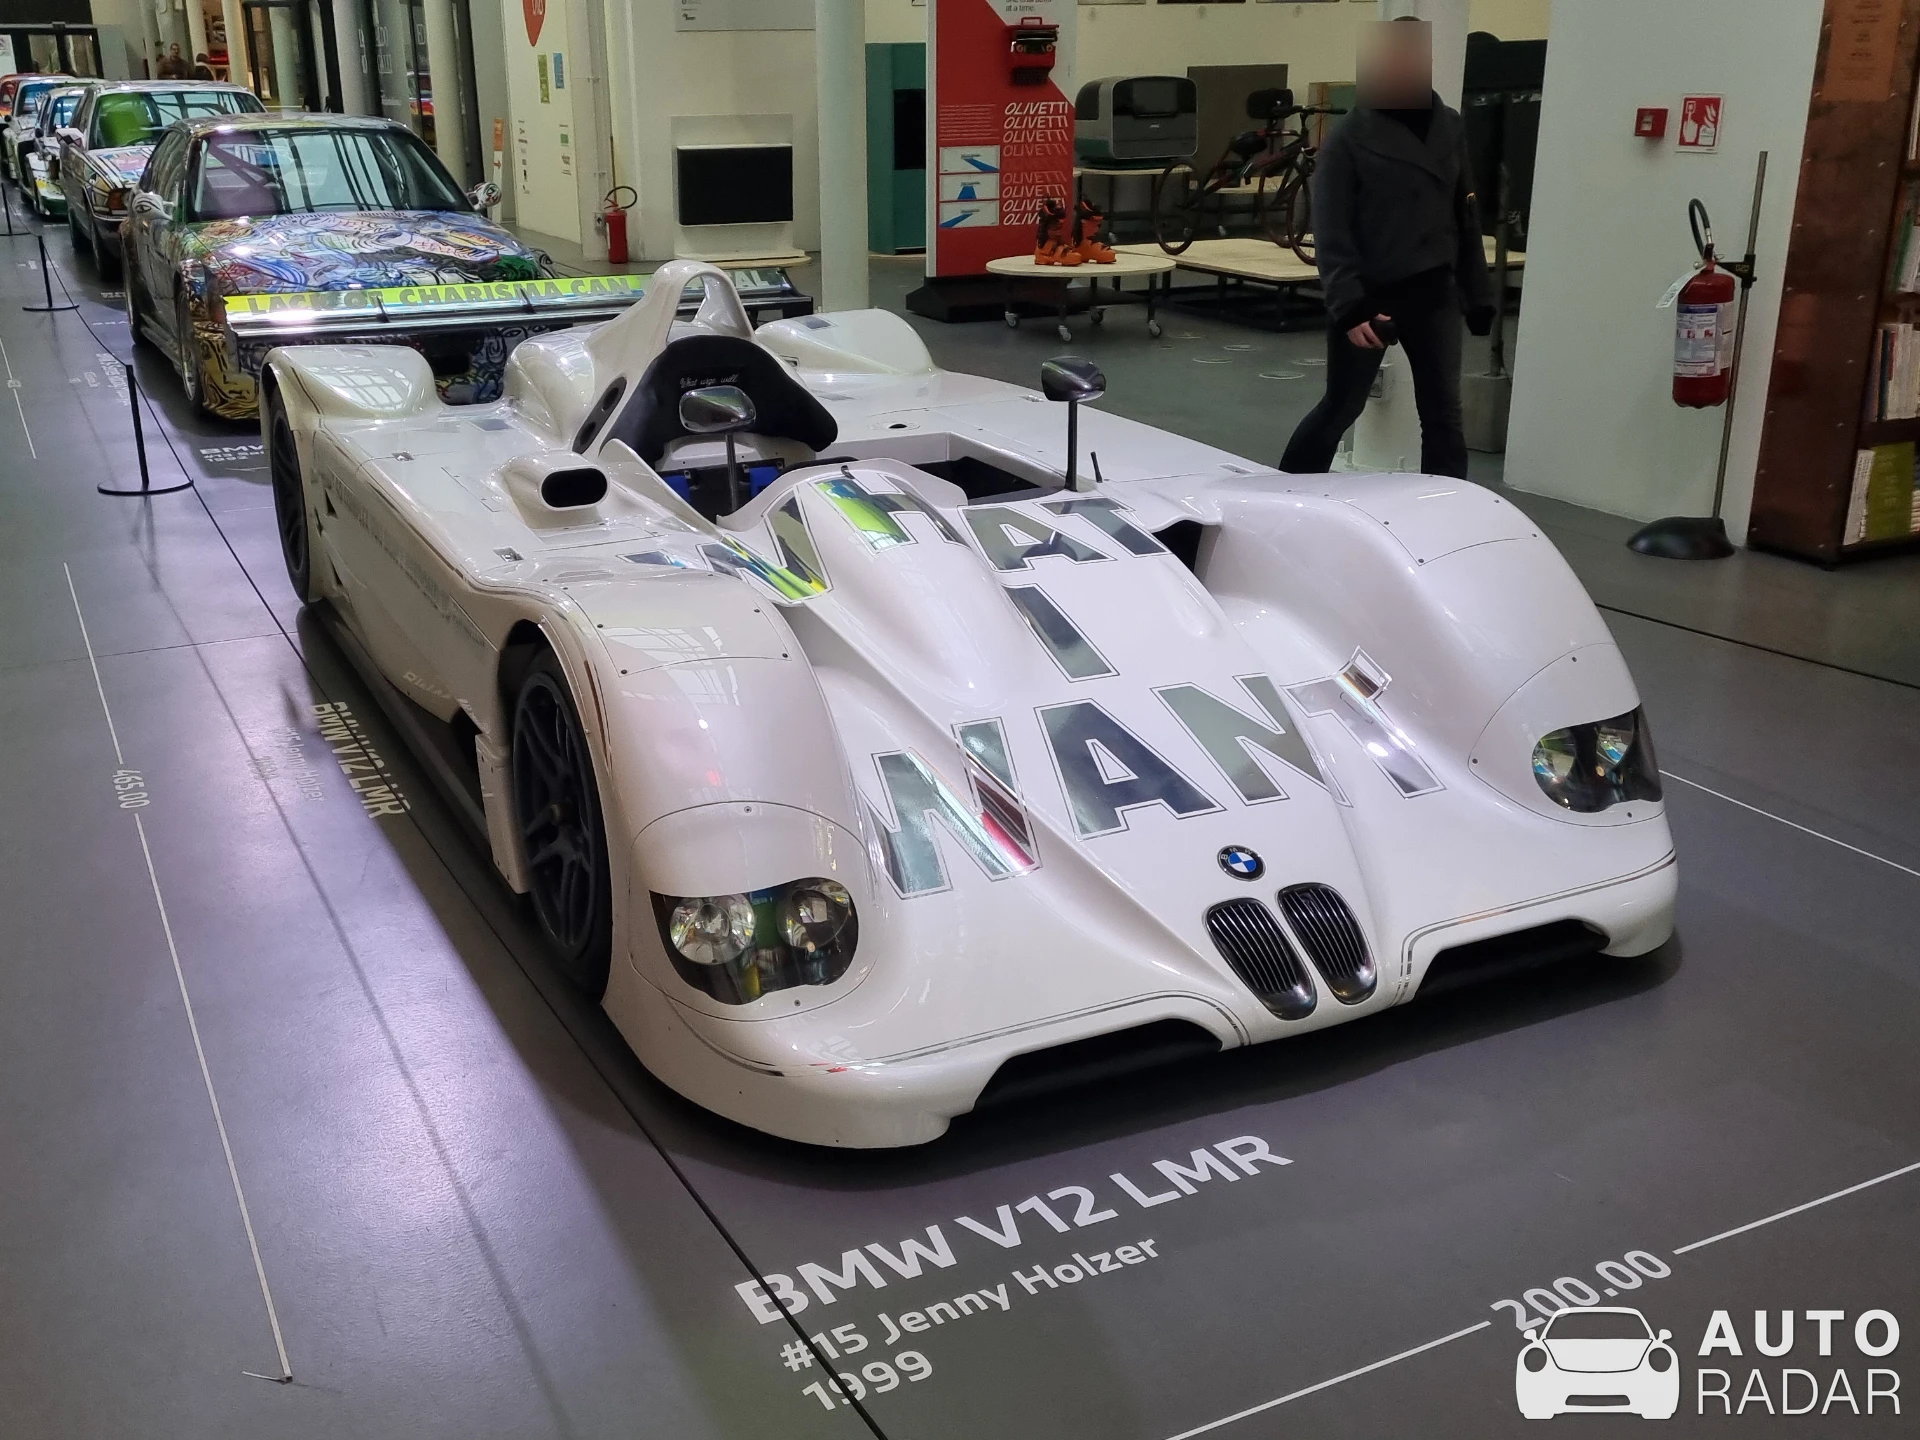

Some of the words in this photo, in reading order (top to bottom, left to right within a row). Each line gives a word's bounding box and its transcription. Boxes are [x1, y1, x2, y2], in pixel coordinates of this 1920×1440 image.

[1004, 101, 1069, 115] OLIVETTI
[1004, 115, 1068, 129] OLIVETTI
[1002, 143, 1068, 157] OLIVETTI
[1003, 129, 1069, 143] OLIVETTI
[1002, 170, 1068, 184] OLIVETTI
[1002, 184, 1067, 198] OLIVETTI
[401, 277, 554, 307] CHARISMA
[570, 276, 633, 295] CAN
[1000, 583, 1121, 682] I
[112, 769, 151, 809] 465.00
[856, 645, 1448, 900] WANT
[348, 773, 411, 819] LMR
[734, 1225, 957, 1325] BMW
[955, 1185, 1119, 1249] V12
[1109, 1134, 1294, 1208] LMR
[780, 1323, 869, 1372] #15
[877, 1283, 1011, 1345] Jenny
[1011, 1237, 1159, 1295] Holzer
[1490, 1249, 1672, 1332] 200.00
[802, 1350, 934, 1412] 1999
